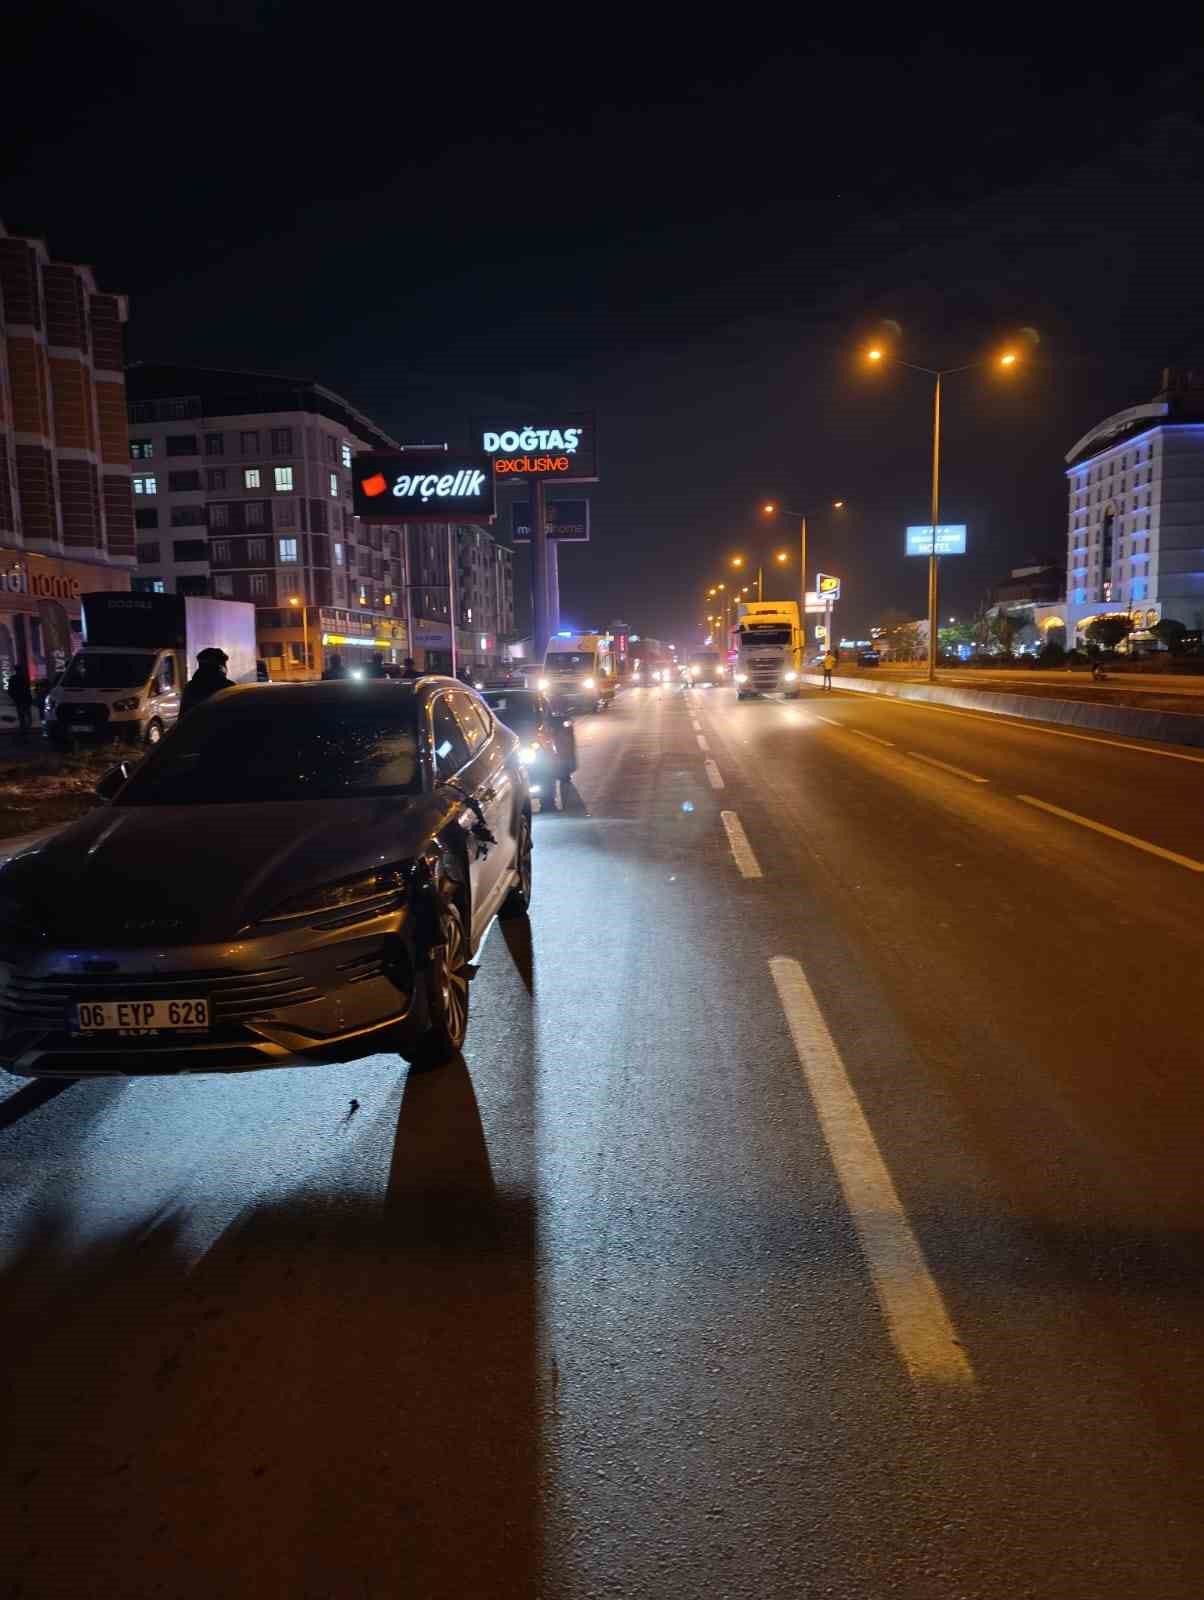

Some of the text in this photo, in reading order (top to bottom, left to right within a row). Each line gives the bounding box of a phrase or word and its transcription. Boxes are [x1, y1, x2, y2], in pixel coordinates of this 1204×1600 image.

[483, 426, 580, 453] DOĞTAŞ
[495, 454, 569, 472] exclusive
[392, 469, 485, 503] arçelik
[80, 1002, 206, 1026] 06 EYP 628
